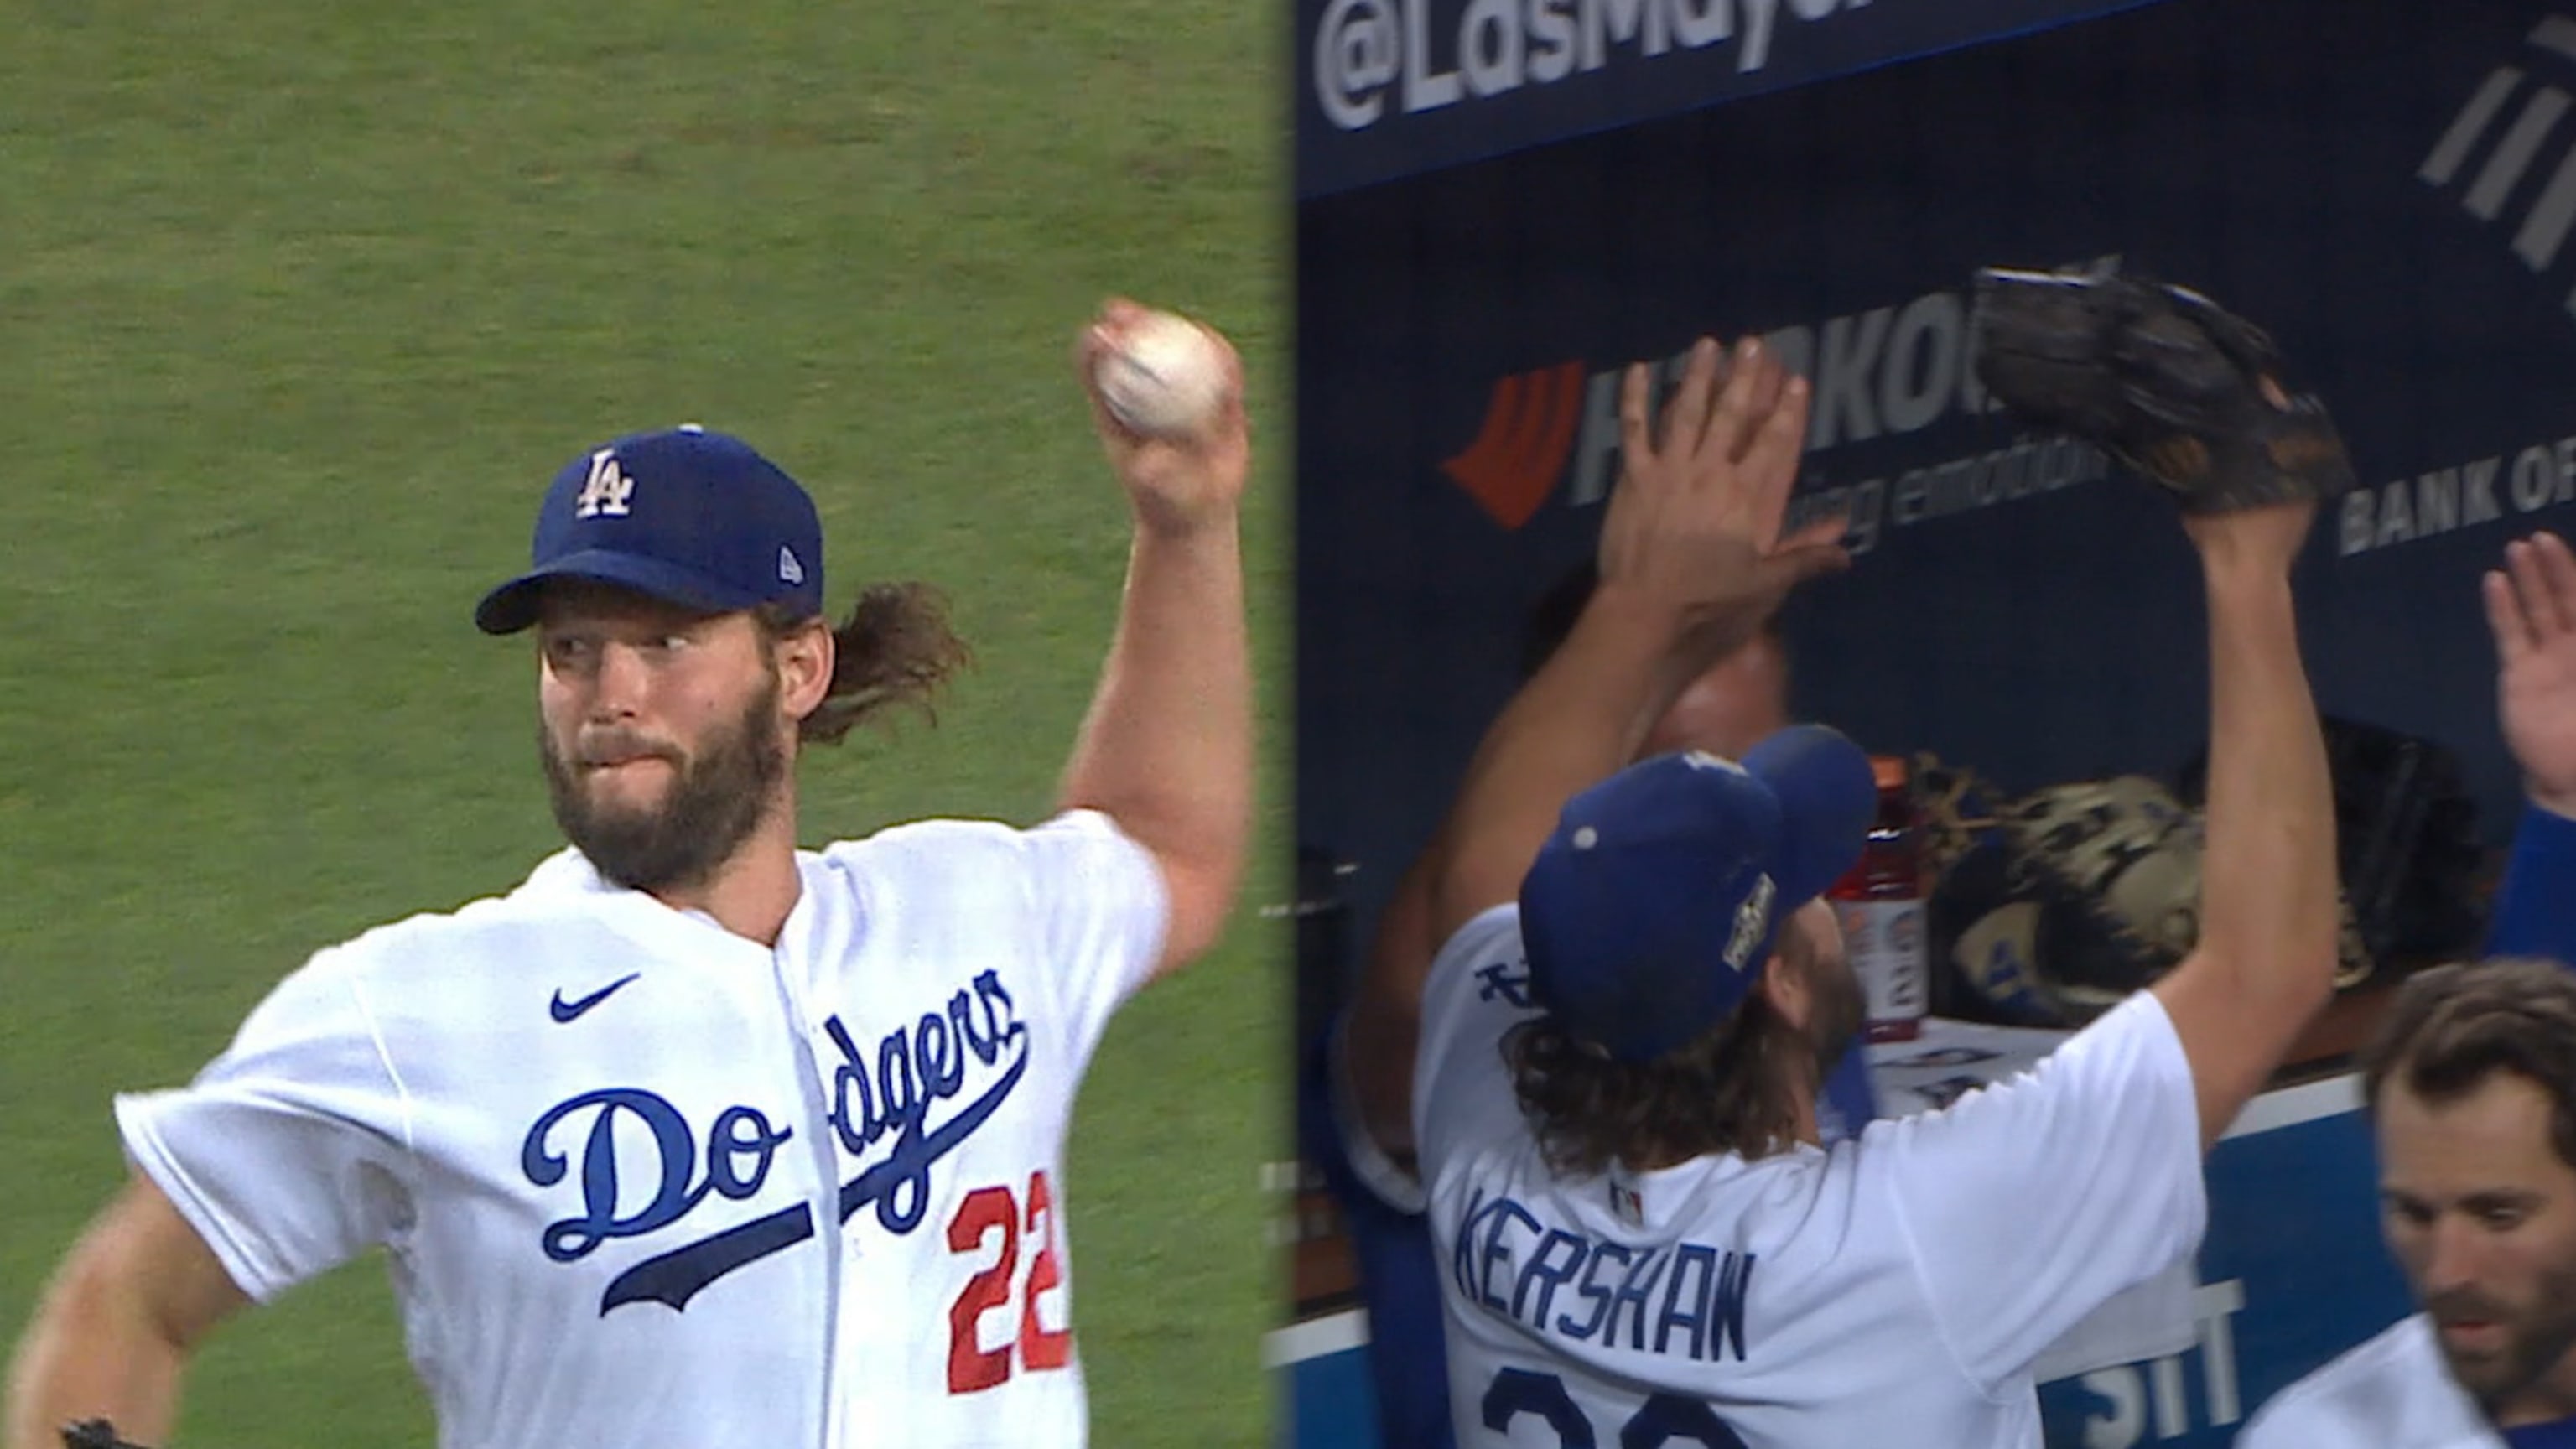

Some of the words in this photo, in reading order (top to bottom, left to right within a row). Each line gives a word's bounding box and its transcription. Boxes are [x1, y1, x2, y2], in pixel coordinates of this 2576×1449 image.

[1313, 0, 1875, 130] @LasMay
[576, 447, 634, 519] LA
[2339, 456, 2502, 557] BANK
[2511, 436, 2576, 513] OF
[521, 969, 1031, 1263] Dodgers
[947, 1170, 1071, 1396] 22
[1455, 1187, 1757, 1363] KERSHAW
